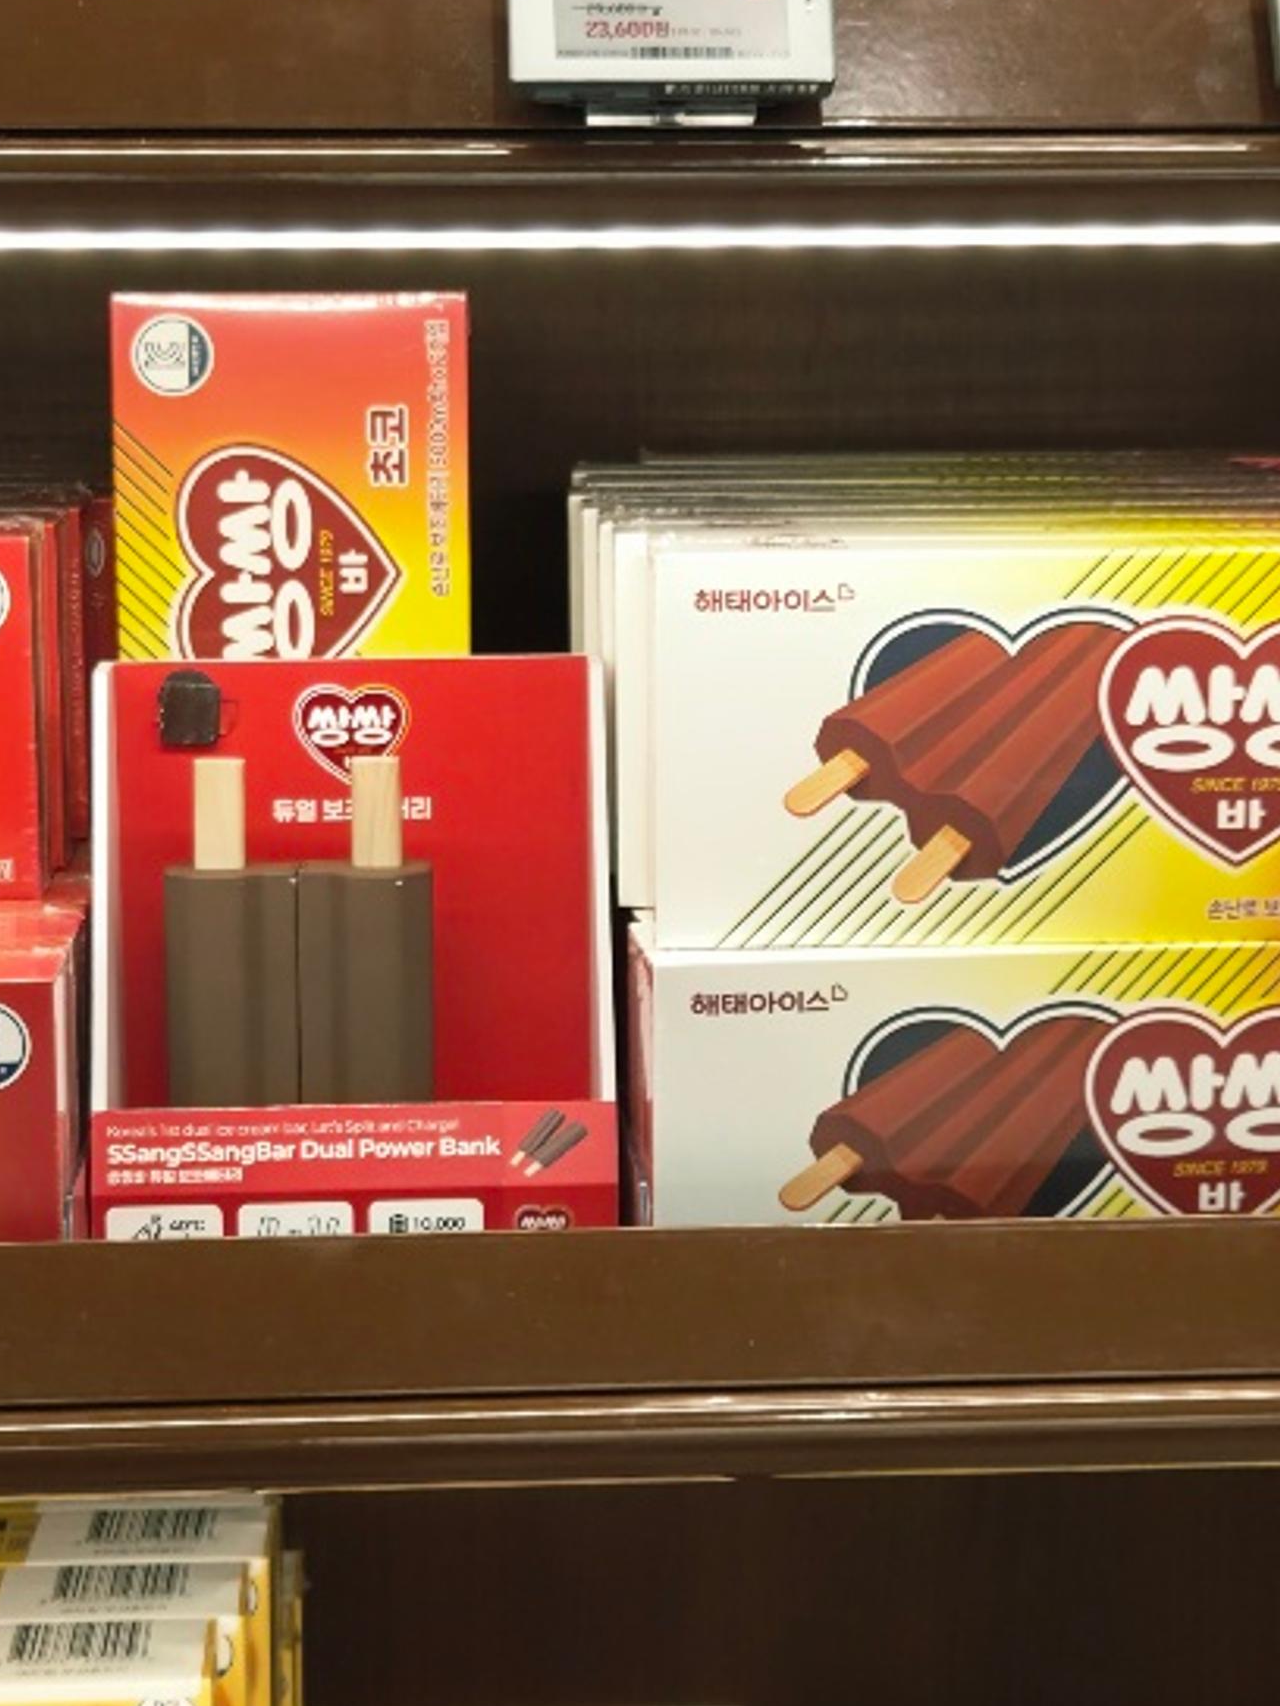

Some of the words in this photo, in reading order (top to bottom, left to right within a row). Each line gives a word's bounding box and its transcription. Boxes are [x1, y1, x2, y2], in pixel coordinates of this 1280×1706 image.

[367, 405, 409, 487] 초코
[338, 550, 369, 594] 바
[694, 587, 837, 613] 해태아이스
[305, 704, 399, 748] 쌍쌍
[1191, 776, 1245, 795] SINCE
[271, 798, 319, 823] 듀얼
[1217, 799, 1265, 830] 바
[690, 990, 830, 1016] 해태아이스
[106, 1139, 296, 1168] SSangSSangBar
[300, 1138, 355, 1161] Dual
[359, 1137, 434, 1160] Power
[438, 1136, 502, 1157] Bank
[1172, 1160, 1224, 1177] SINCE
[1198, 1181, 1245, 1213] 바
